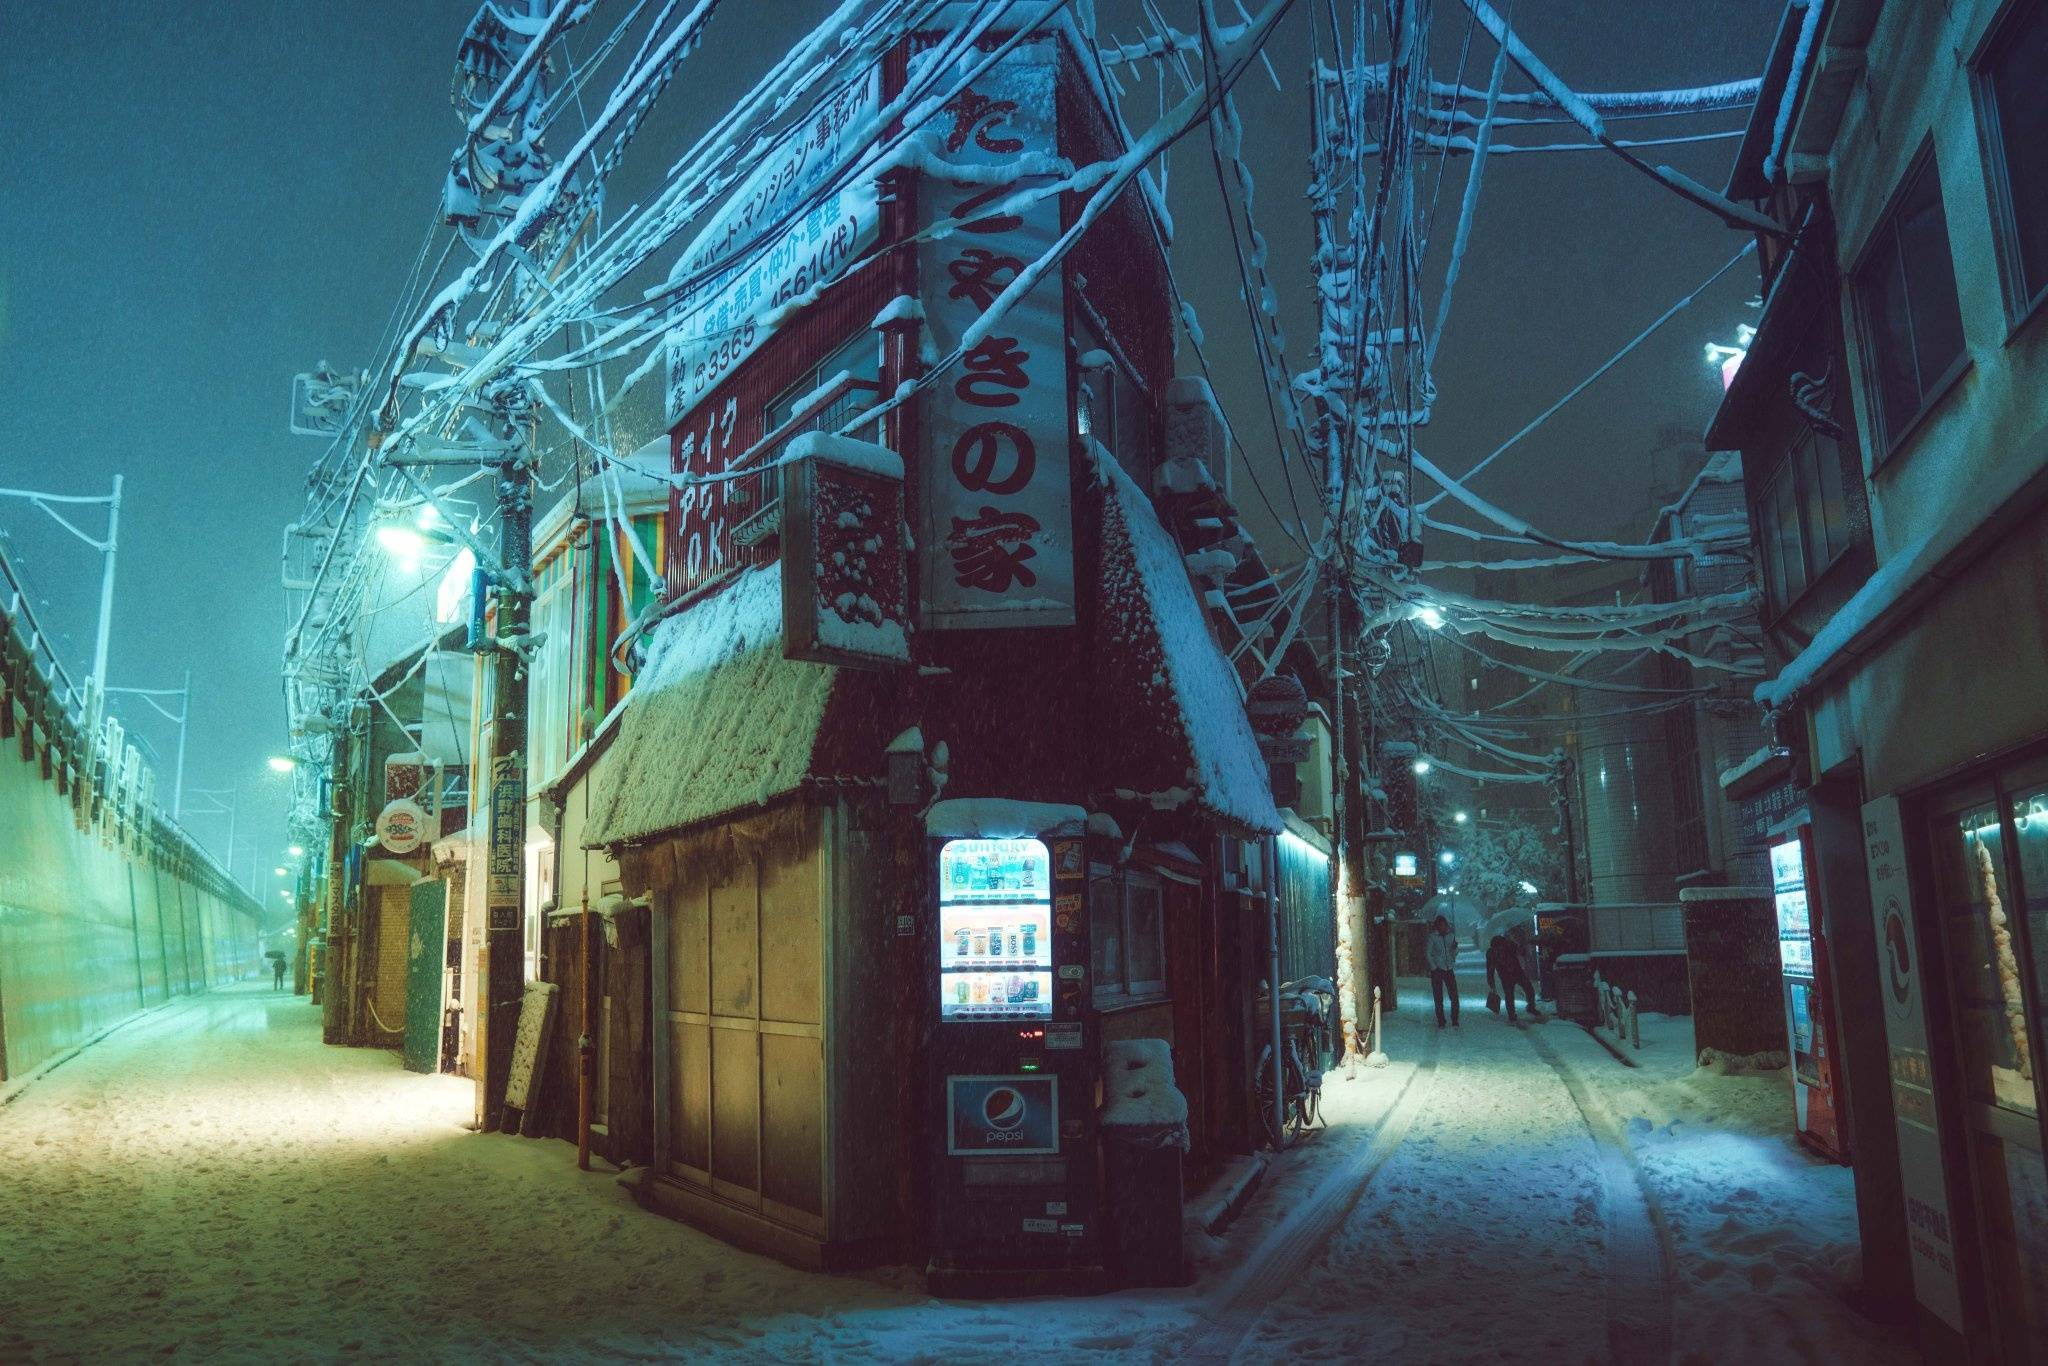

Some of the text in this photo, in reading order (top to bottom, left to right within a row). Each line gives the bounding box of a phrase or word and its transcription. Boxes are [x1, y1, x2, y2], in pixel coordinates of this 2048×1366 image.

[947, 88, 1040, 594] たこやきの家
[687, 516, 724, 579] OK
[1010, 935, 1018, 954] BOSS
[986, 1129, 1024, 1143] pepsi
